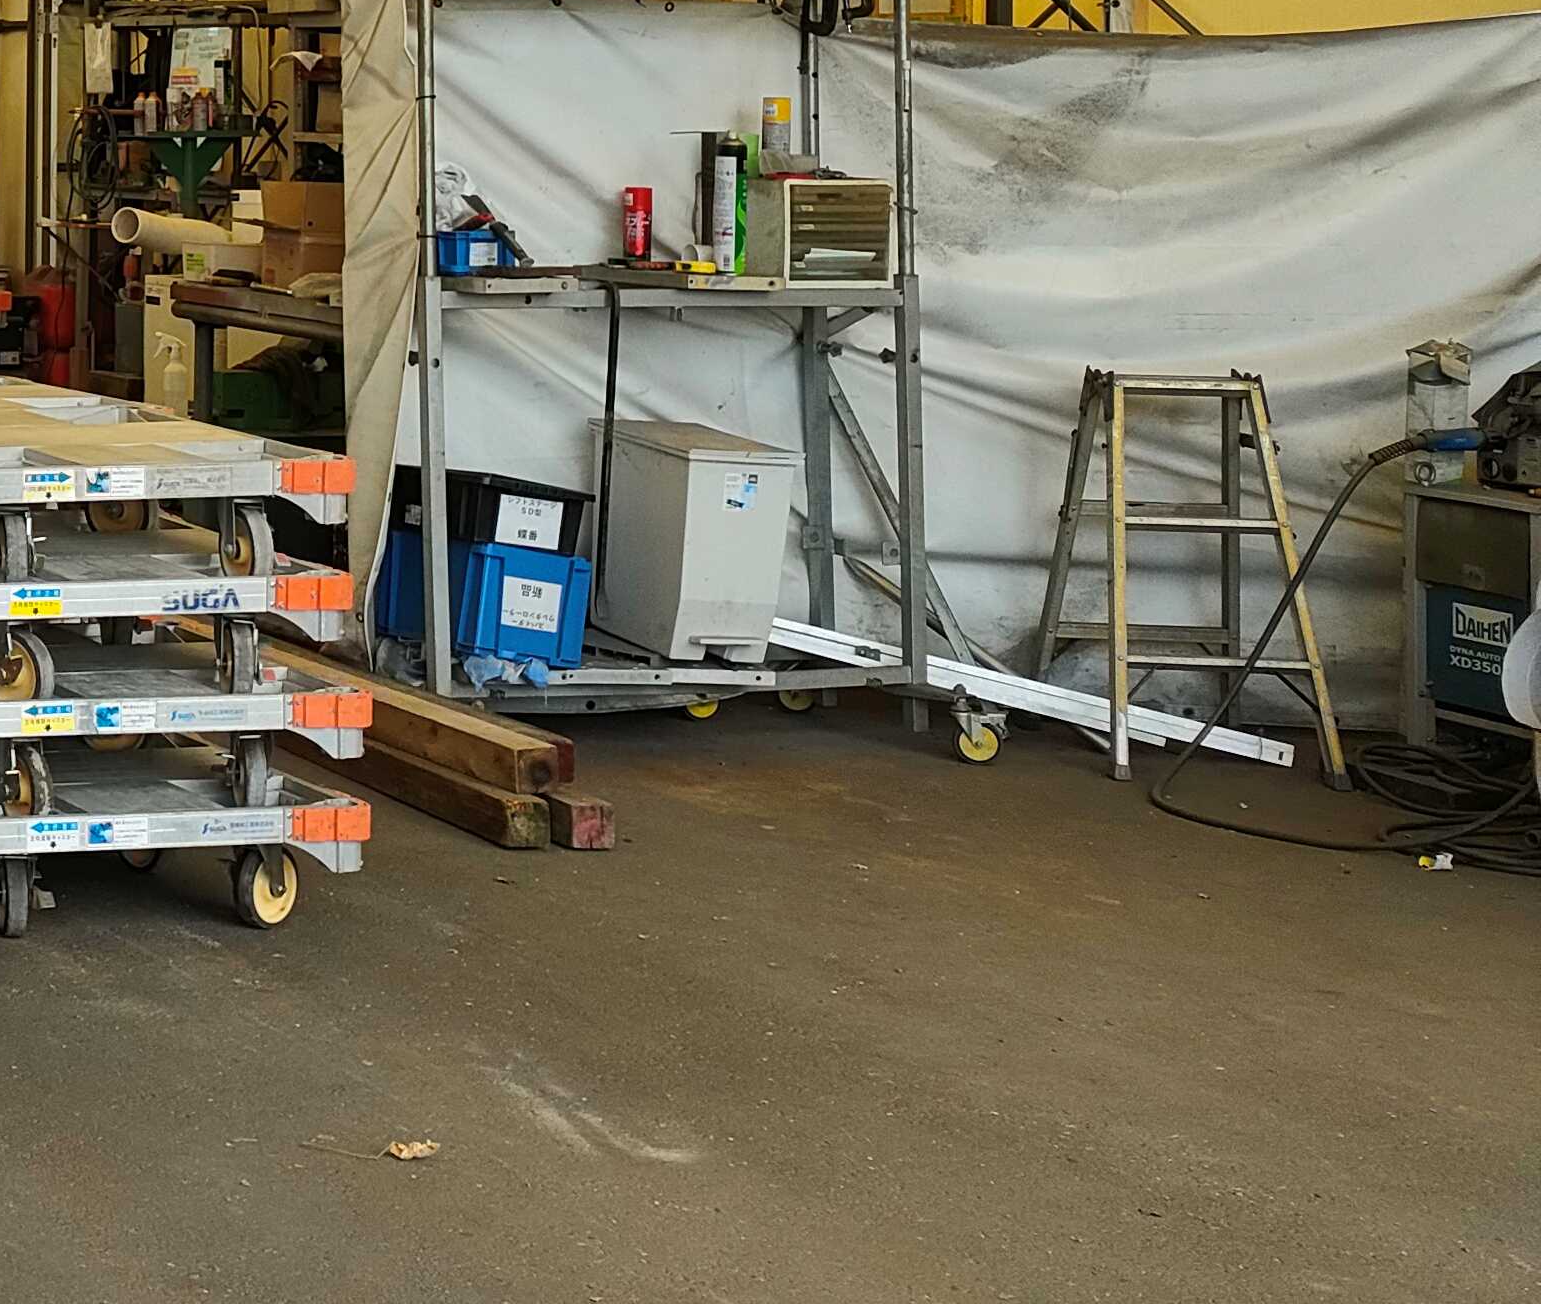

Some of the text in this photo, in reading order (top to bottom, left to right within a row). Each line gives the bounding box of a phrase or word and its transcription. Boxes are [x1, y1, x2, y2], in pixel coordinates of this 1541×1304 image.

[1455, 607, 1511, 645] DAIHEN
[1449, 655, 1502, 675] XD350
[1477, 651, 1501, 662] AUTO
